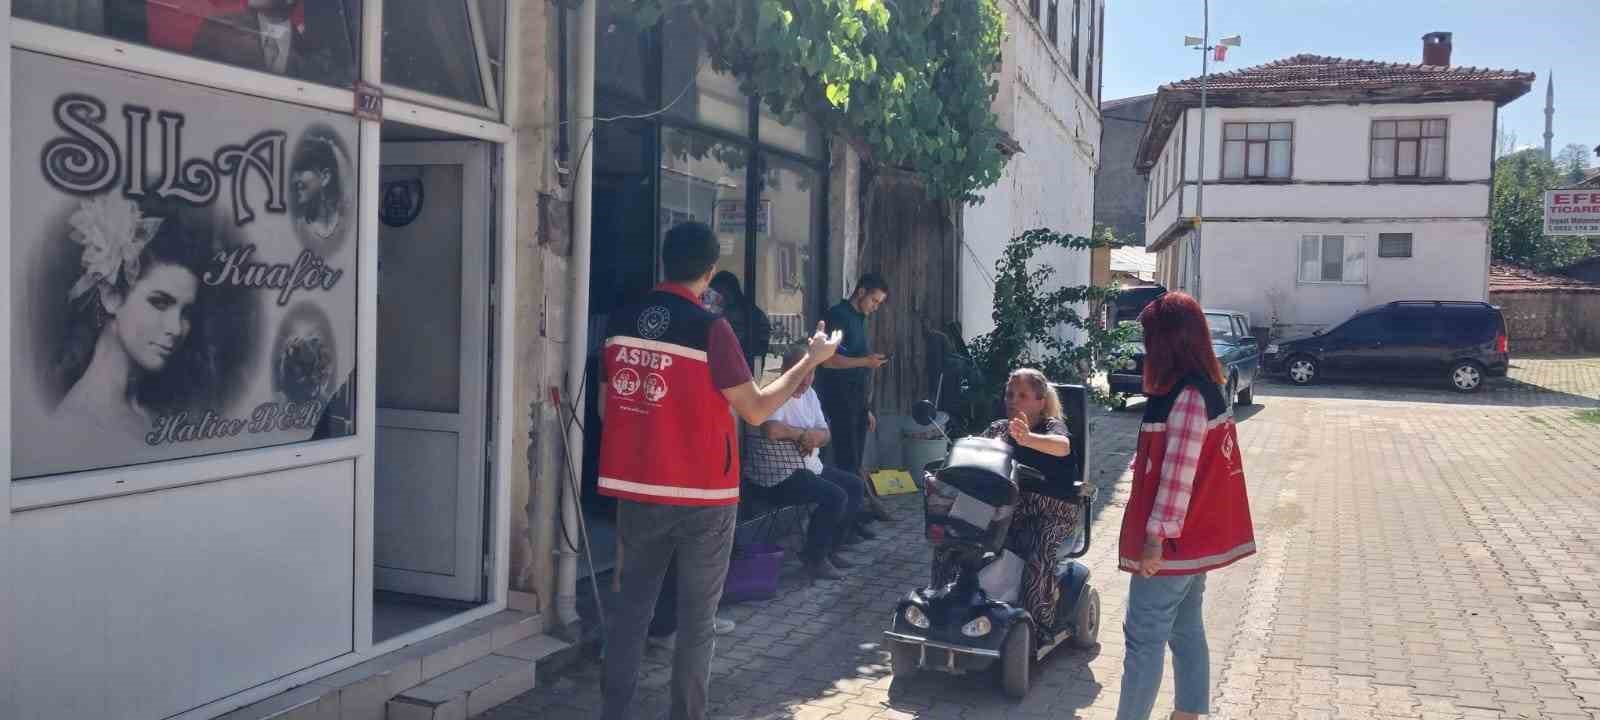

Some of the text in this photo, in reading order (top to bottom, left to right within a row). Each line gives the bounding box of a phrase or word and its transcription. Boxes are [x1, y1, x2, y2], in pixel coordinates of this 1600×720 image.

[41, 92, 287, 226] SILA
[1554, 193, 1600, 205] EFE
[201, 244, 344, 306] Kuaför
[615, 346, 673, 371] ASDEP
[145, 408, 249, 447] Hatice
